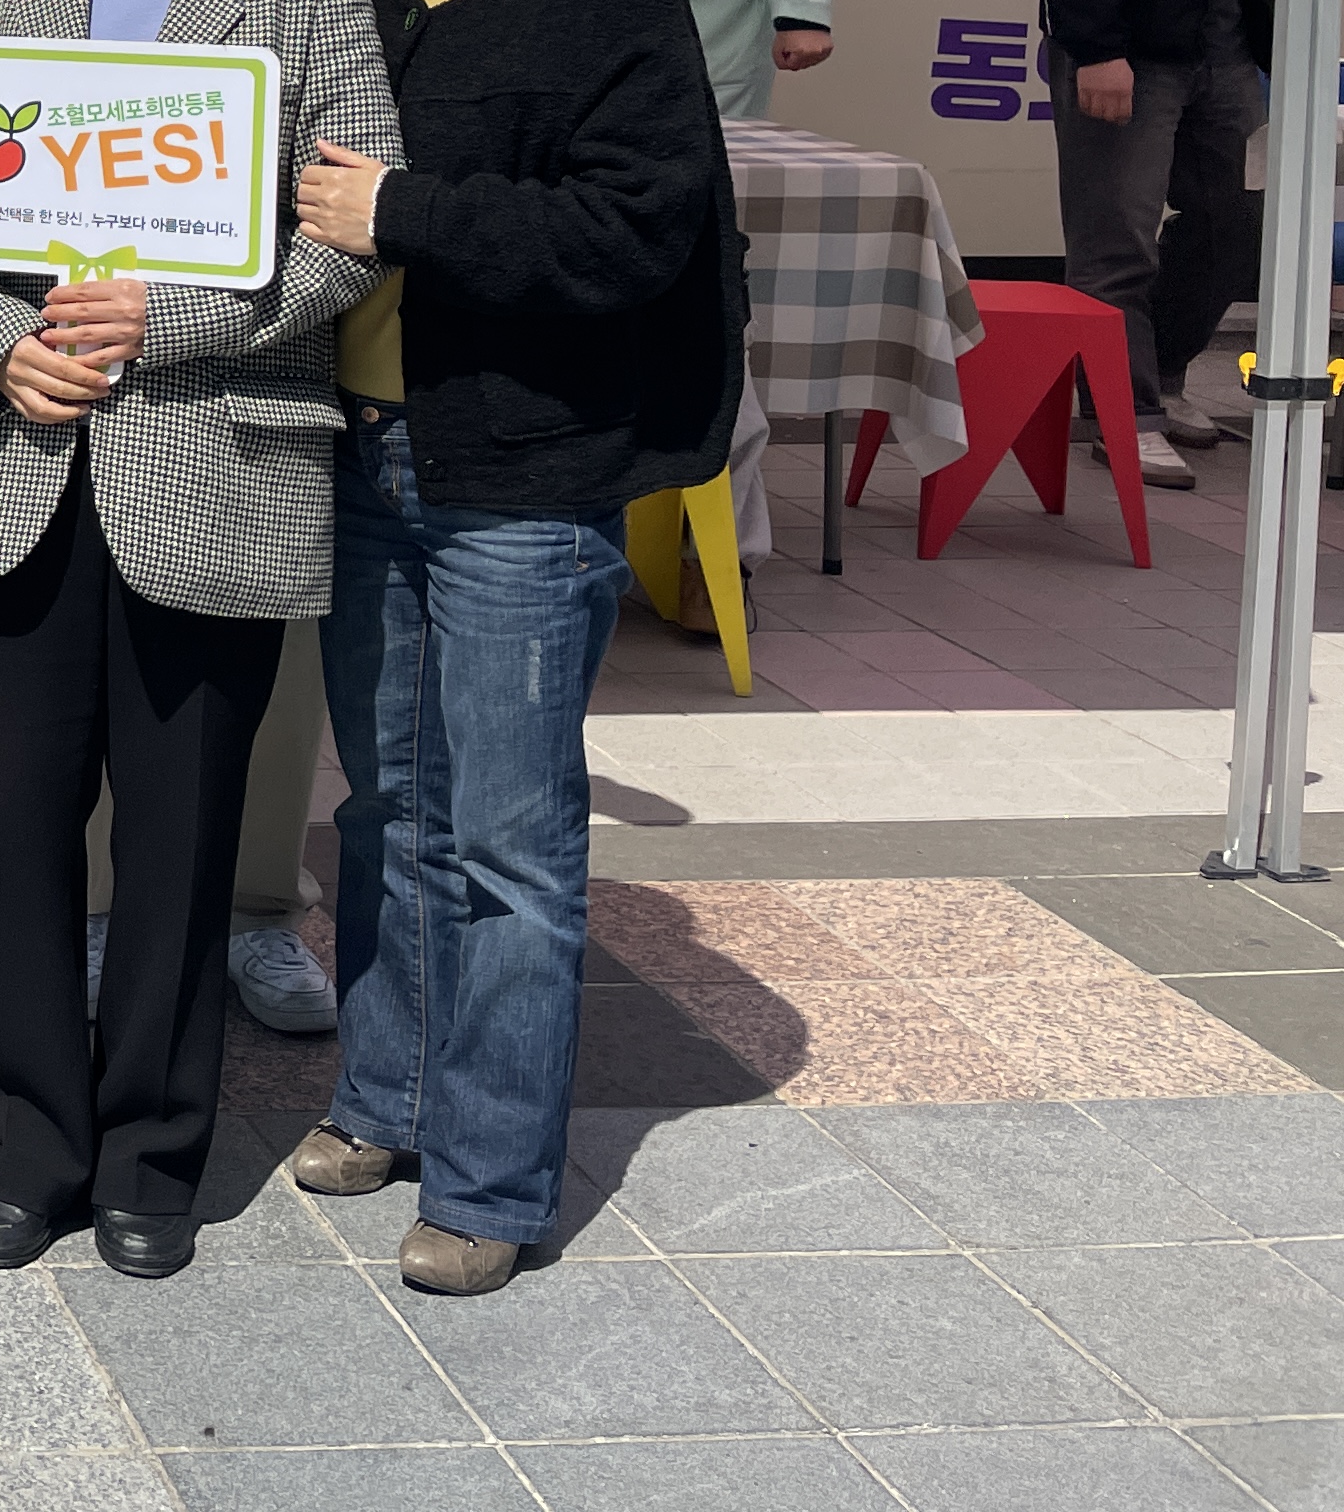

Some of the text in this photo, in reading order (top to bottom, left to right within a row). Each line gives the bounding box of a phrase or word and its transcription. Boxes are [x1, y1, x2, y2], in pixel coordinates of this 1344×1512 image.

[46, 90, 226, 128] 조혈모세포희망등록
[38, 120, 229, 192] YES!
[39, 209, 52, 224] 한
[91, 212, 146, 231] 누구보다
[150, 217, 239, 238] 아름답습니다.
